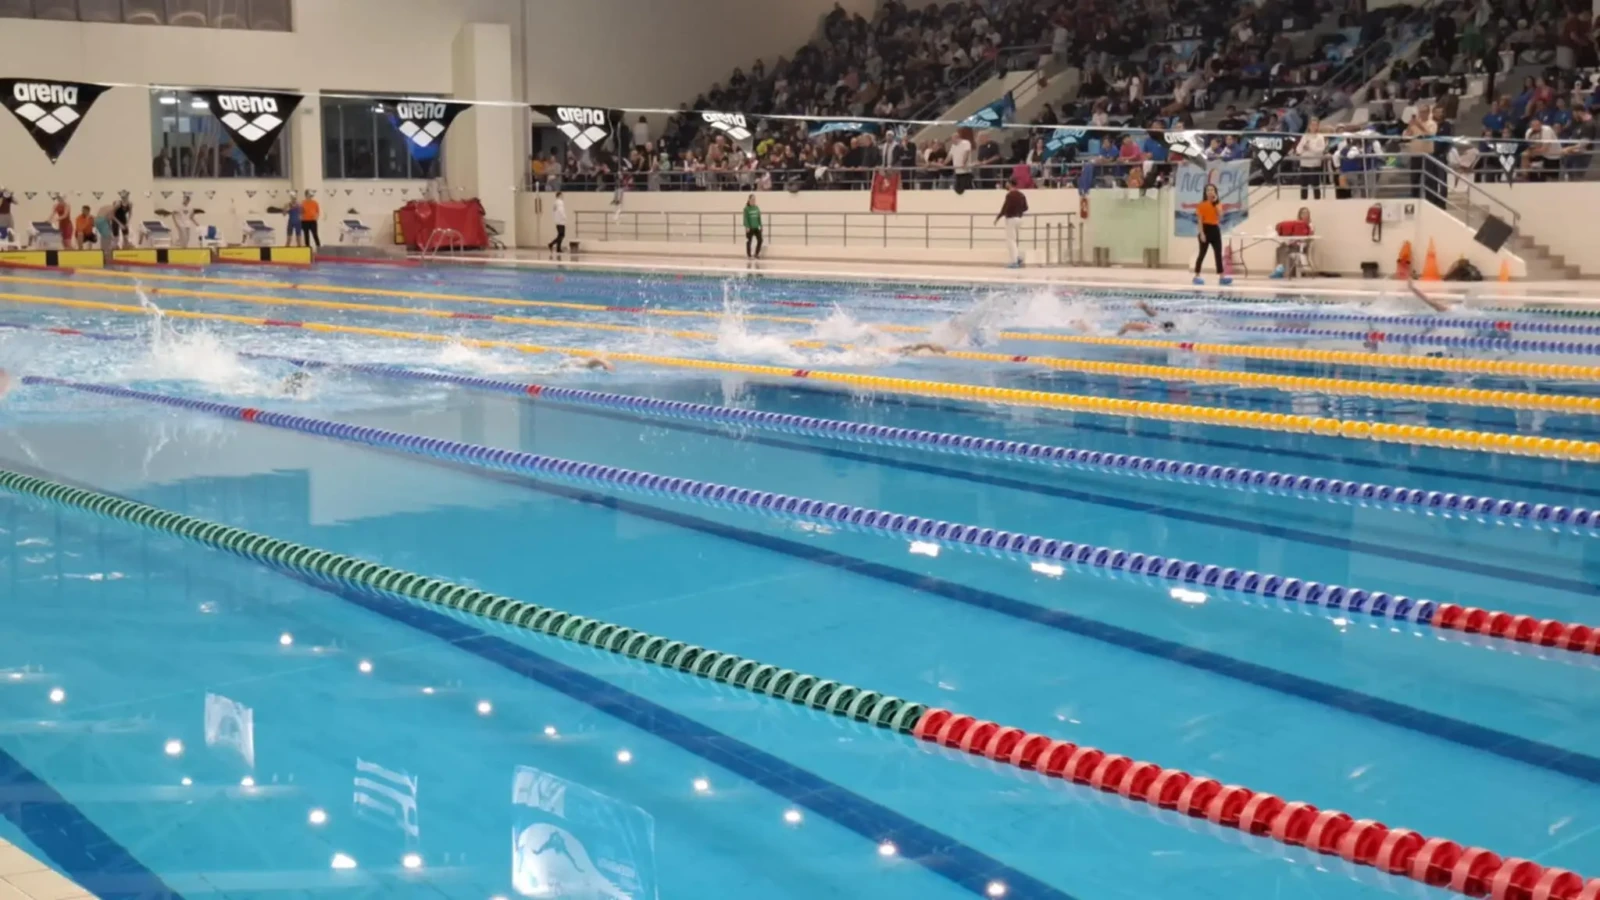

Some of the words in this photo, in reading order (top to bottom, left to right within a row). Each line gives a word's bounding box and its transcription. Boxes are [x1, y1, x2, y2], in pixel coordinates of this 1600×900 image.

[13, 82, 79, 105] arena
[217, 95, 279, 113] arena
[396, 102, 447, 119] arena
[556, 107, 605, 125] arena
